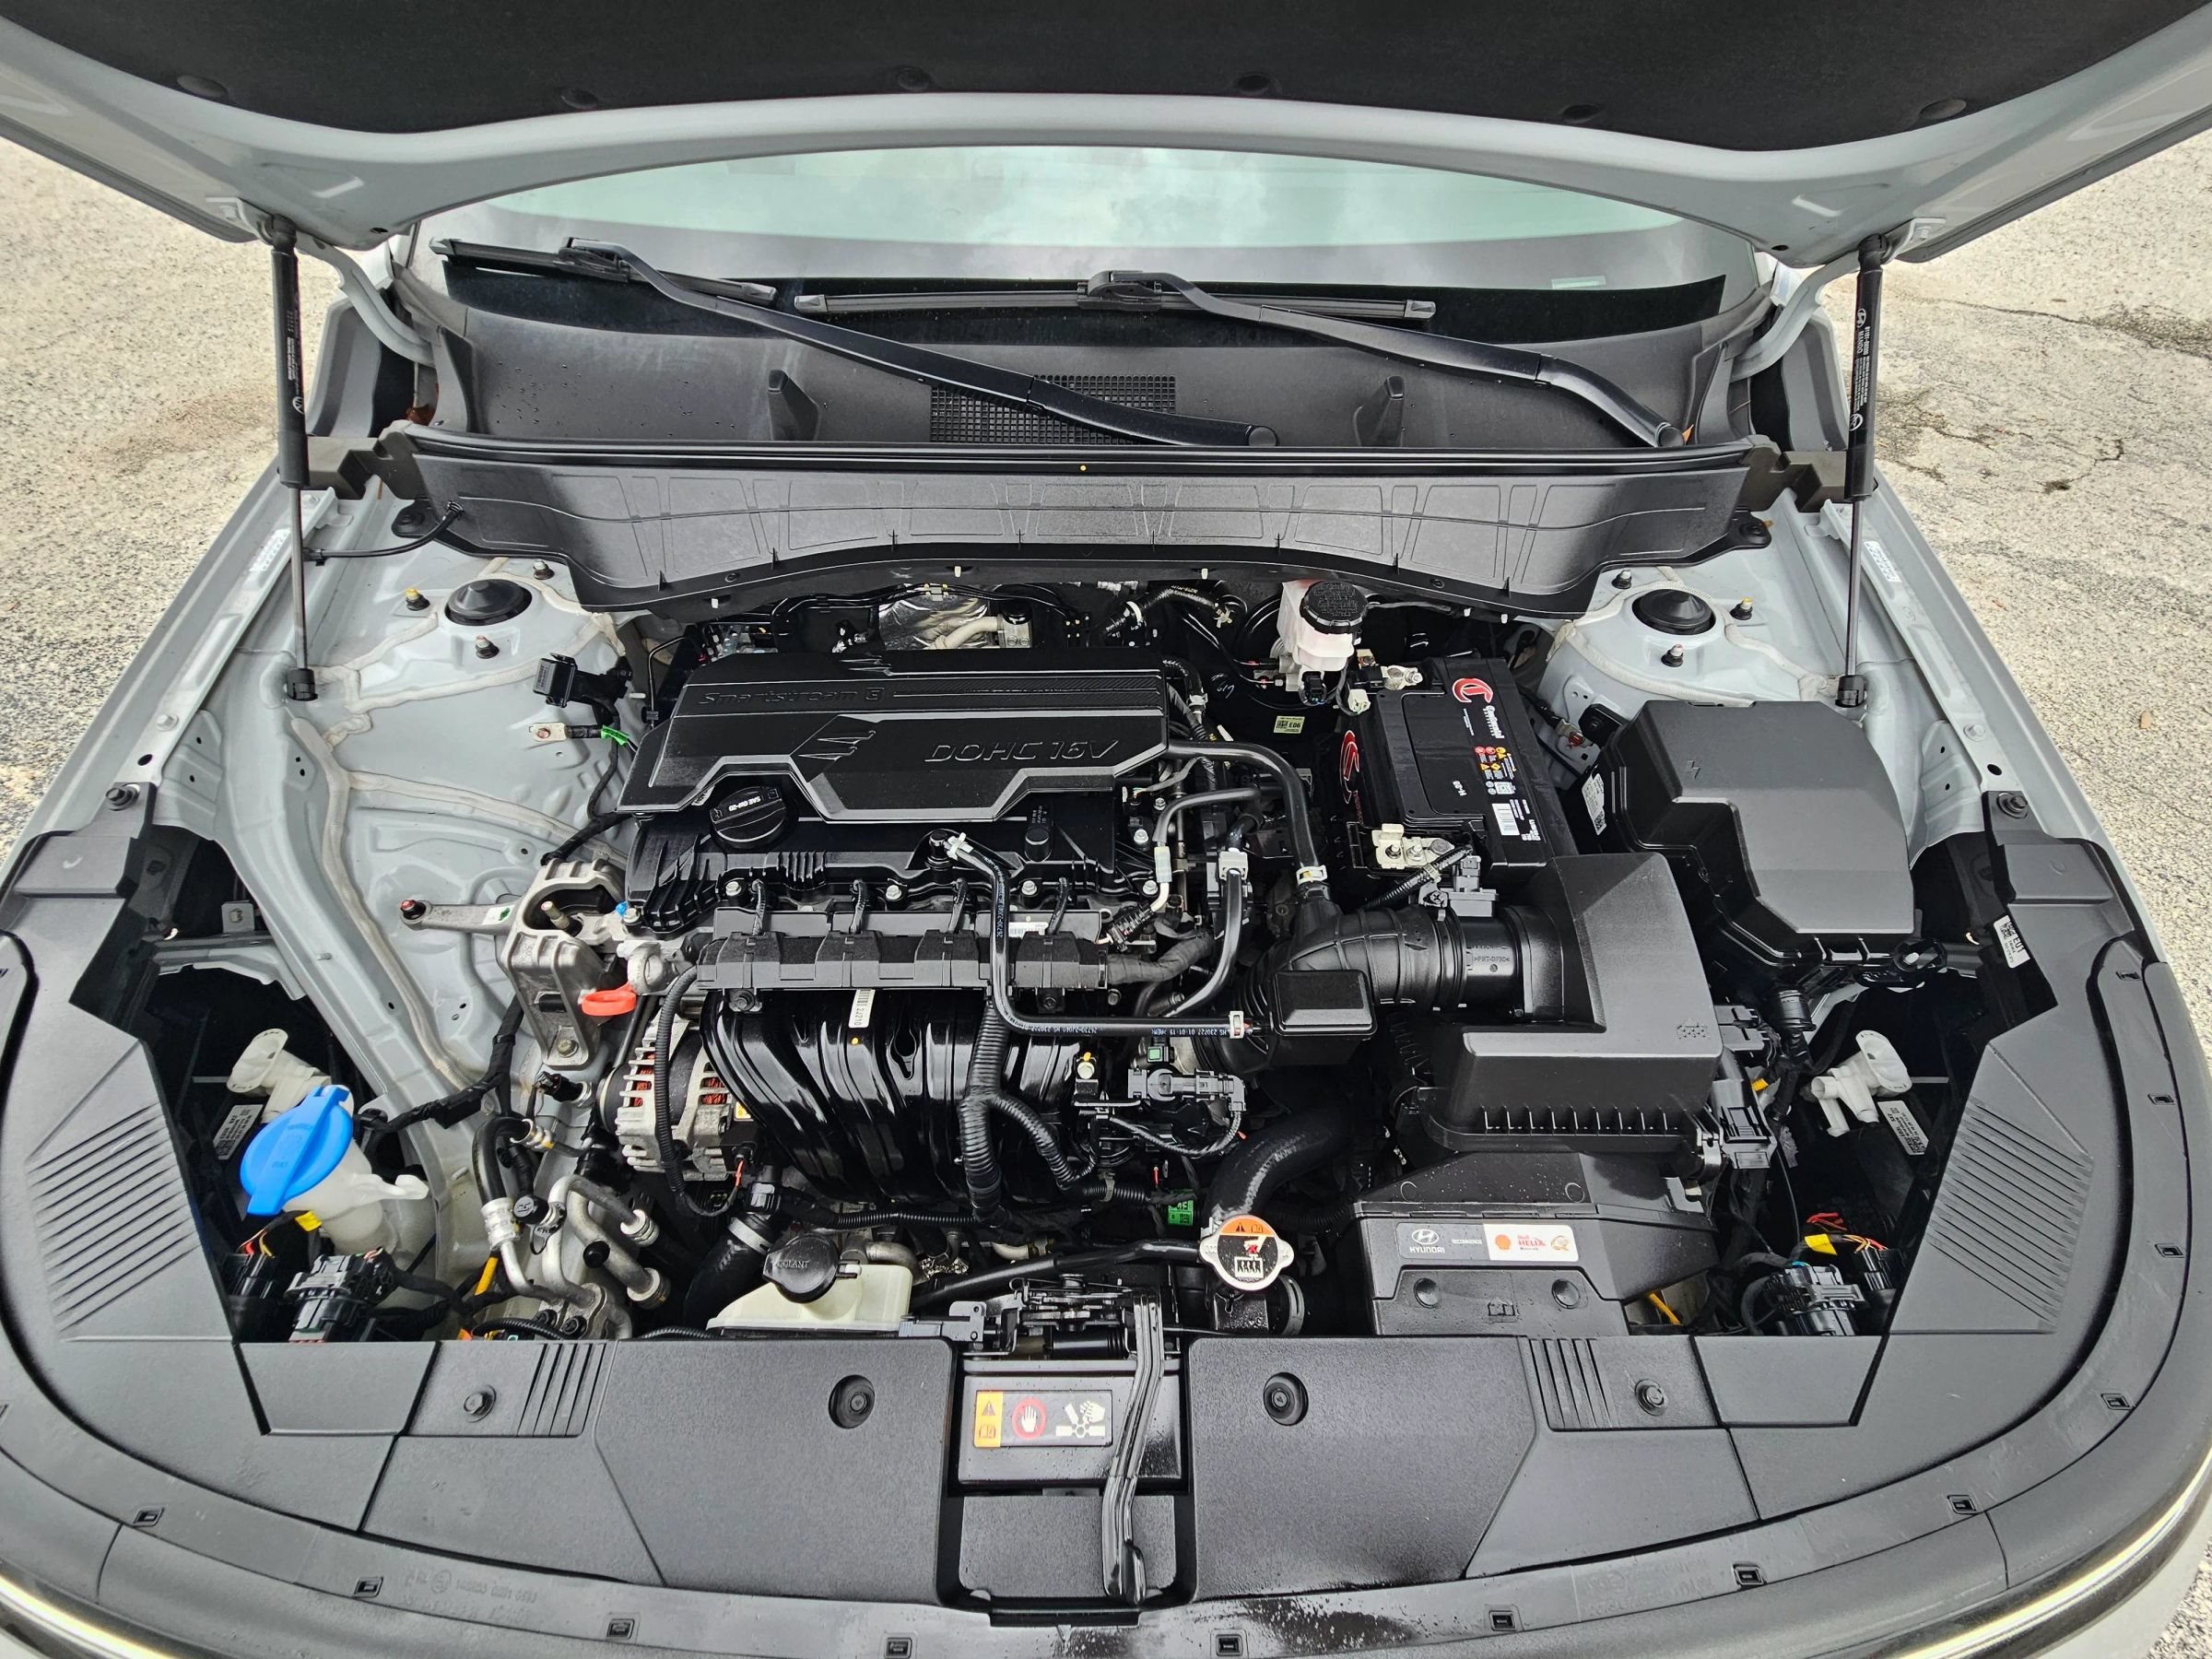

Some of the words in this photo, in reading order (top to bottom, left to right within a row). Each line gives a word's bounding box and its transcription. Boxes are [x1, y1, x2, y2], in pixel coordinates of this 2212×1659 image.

[1485, 705, 1505, 738] Continental
[924, 741, 1043, 762] DOHC
[1050, 740, 1120, 759] 16V
[748, 795, 761, 806] SAE
